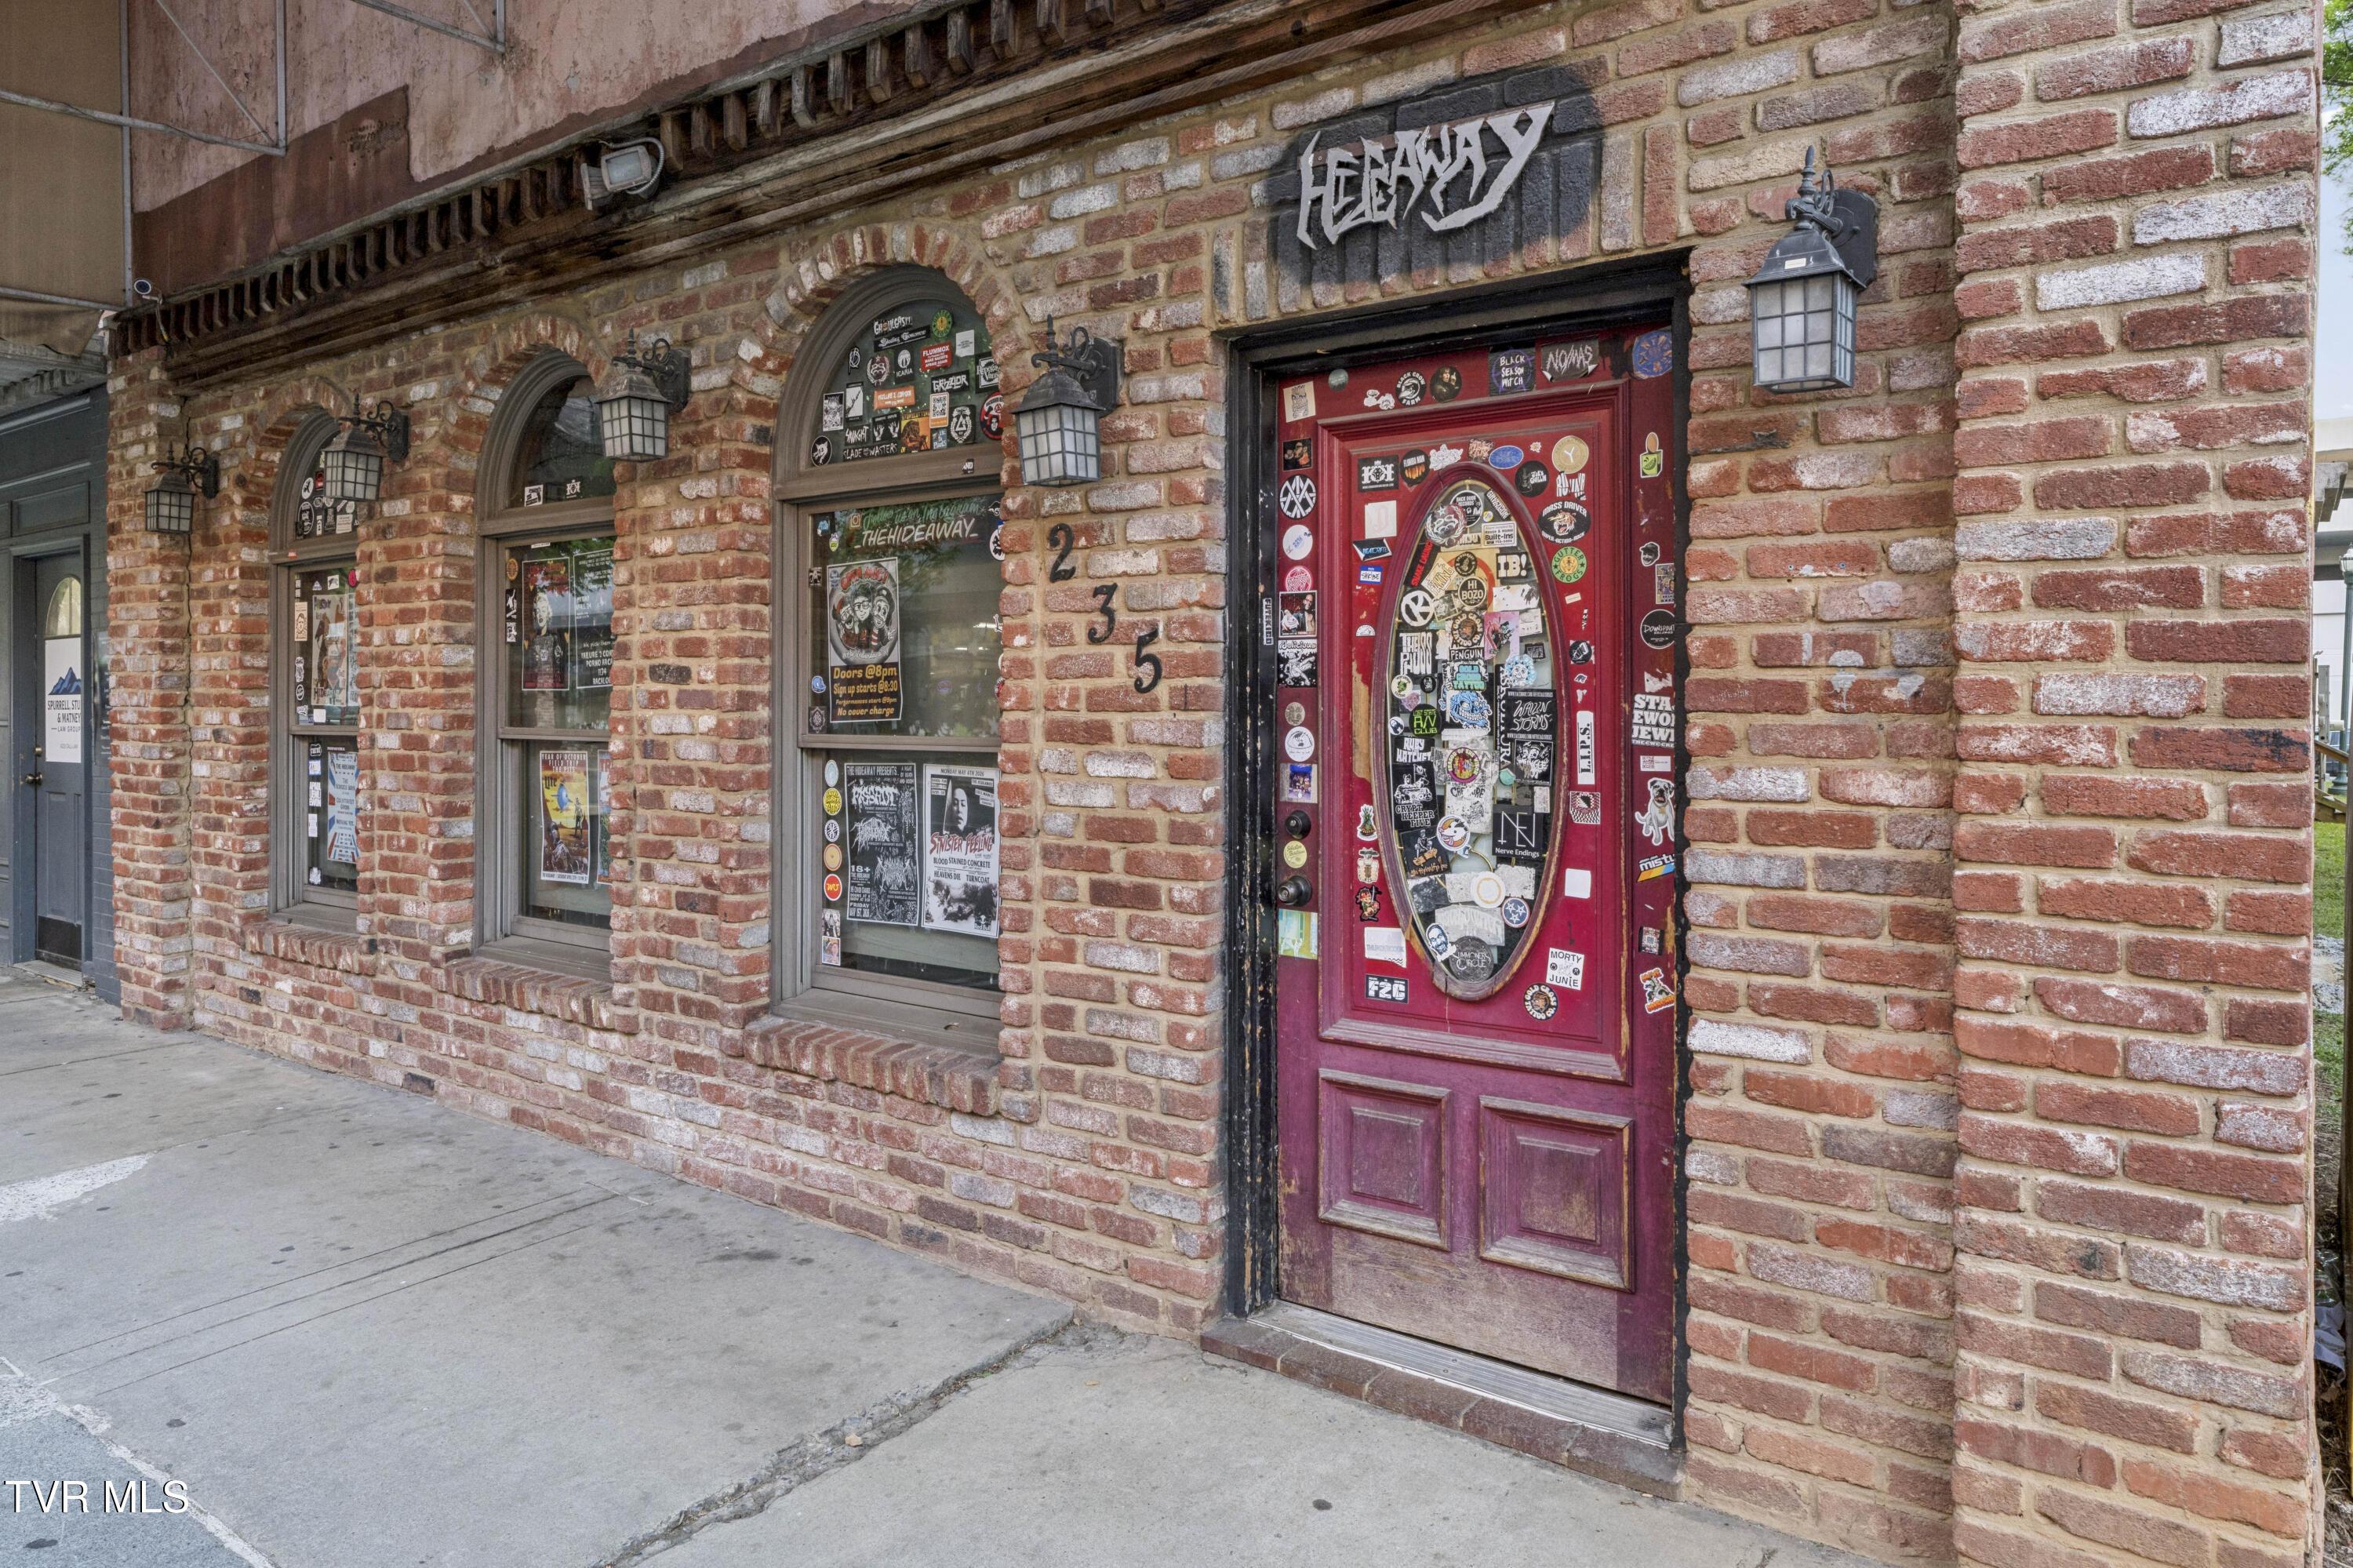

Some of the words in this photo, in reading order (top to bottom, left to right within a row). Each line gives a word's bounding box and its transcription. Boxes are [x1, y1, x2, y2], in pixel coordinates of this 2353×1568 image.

[922, 345, 950, 357] FLUMMOX
[1500, 354, 1525, 367] BLACK
[1501, 367, 1525, 377] SEASON
[1397, 372, 1411, 387] BLACK
[1412, 371, 1426, 385] CROW
[1402, 396, 1421, 406] FARM
[870, 442, 897, 457] WASTERS
[1403, 458, 1417, 467] FLORIDA
[1417, 454, 1425, 463] MAN
[1542, 502, 1562, 518] MASS
[1563, 501, 1587, 518] DRIVER
[1554, 547, 1584, 562] GUTTER
[1497, 554, 1527, 577] IB!
[1555, 570, 1584, 582] FROGS
[1467, 580, 1477, 589] HI
[1461, 589, 1483, 599] BOZO
[1450, 649, 1483, 660] PENGUIN
[833, 667, 864, 679] Doors
[865, 664, 897, 681] @8pm
[833, 683, 847, 697] Sign
[848, 685, 855, 697] up
[856, 683, 877, 693] starts
[878, 680, 898, 693] @8:30
[48, 700, 71, 711] SPURRELL,
[1634, 693, 1675, 711] STA
[837, 708, 847, 716] No
[848, 707, 868, 715] cover
[869, 705, 894, 717] charge
[57, 713, 61, 722] &
[1413, 715, 1437, 729] A/V
[855, 766, 875, 776] HIDEAWAY
[1395, 804, 1422, 813] CRYPT
[1402, 810, 1435, 820] KEEPER
[1410, 819, 1431, 828] FIVE
[1495, 847, 1514, 856] Nerve
[1515, 849, 1540, 858] Endings
[948, 857, 967, 865] STAINED
[967, 859, 991, 868] CONCRETE
[933, 871, 953, 879] HEAVENS
[966, 875, 990, 884] TURNCOAT
[1551, 951, 1582, 964] MORTY
[1368, 980, 1406, 1000] F2C
